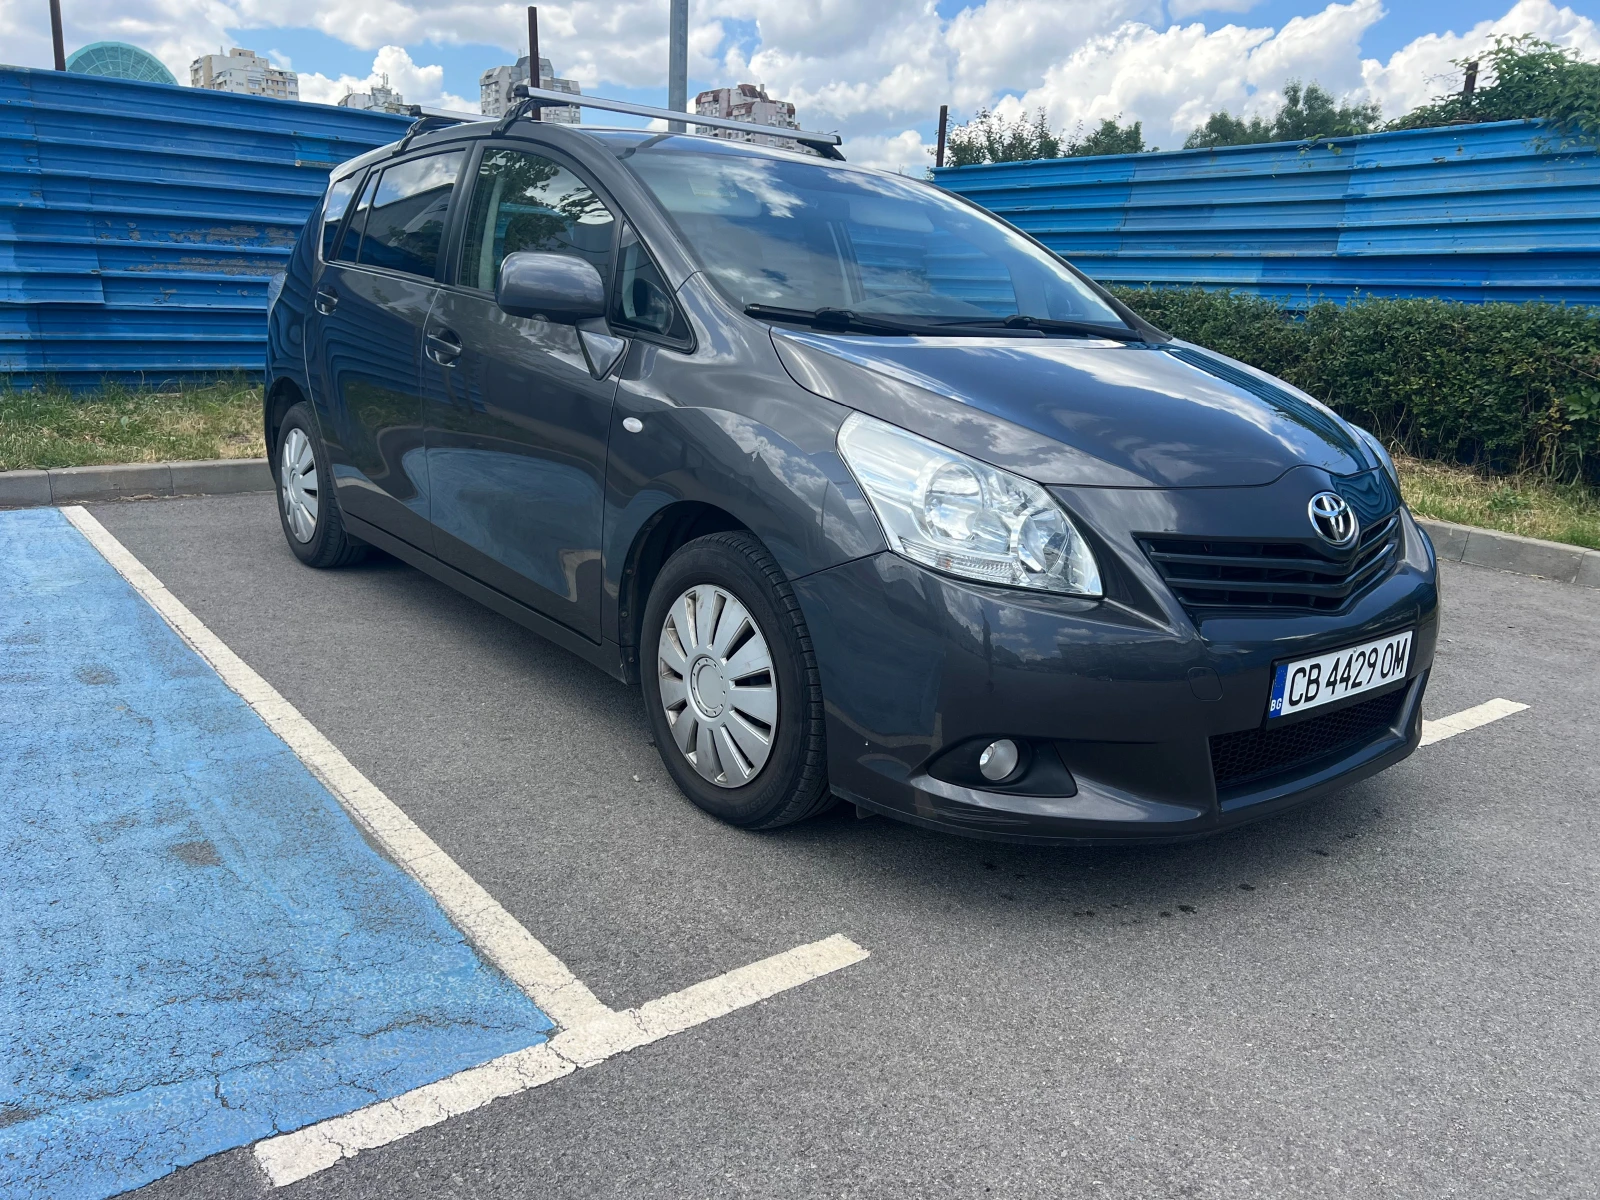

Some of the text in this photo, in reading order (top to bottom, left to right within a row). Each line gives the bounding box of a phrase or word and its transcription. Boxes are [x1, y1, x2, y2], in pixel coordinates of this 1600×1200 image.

[1288, 638, 1408, 706] CB 4429 OM
[1270, 698, 1282, 712] BG
